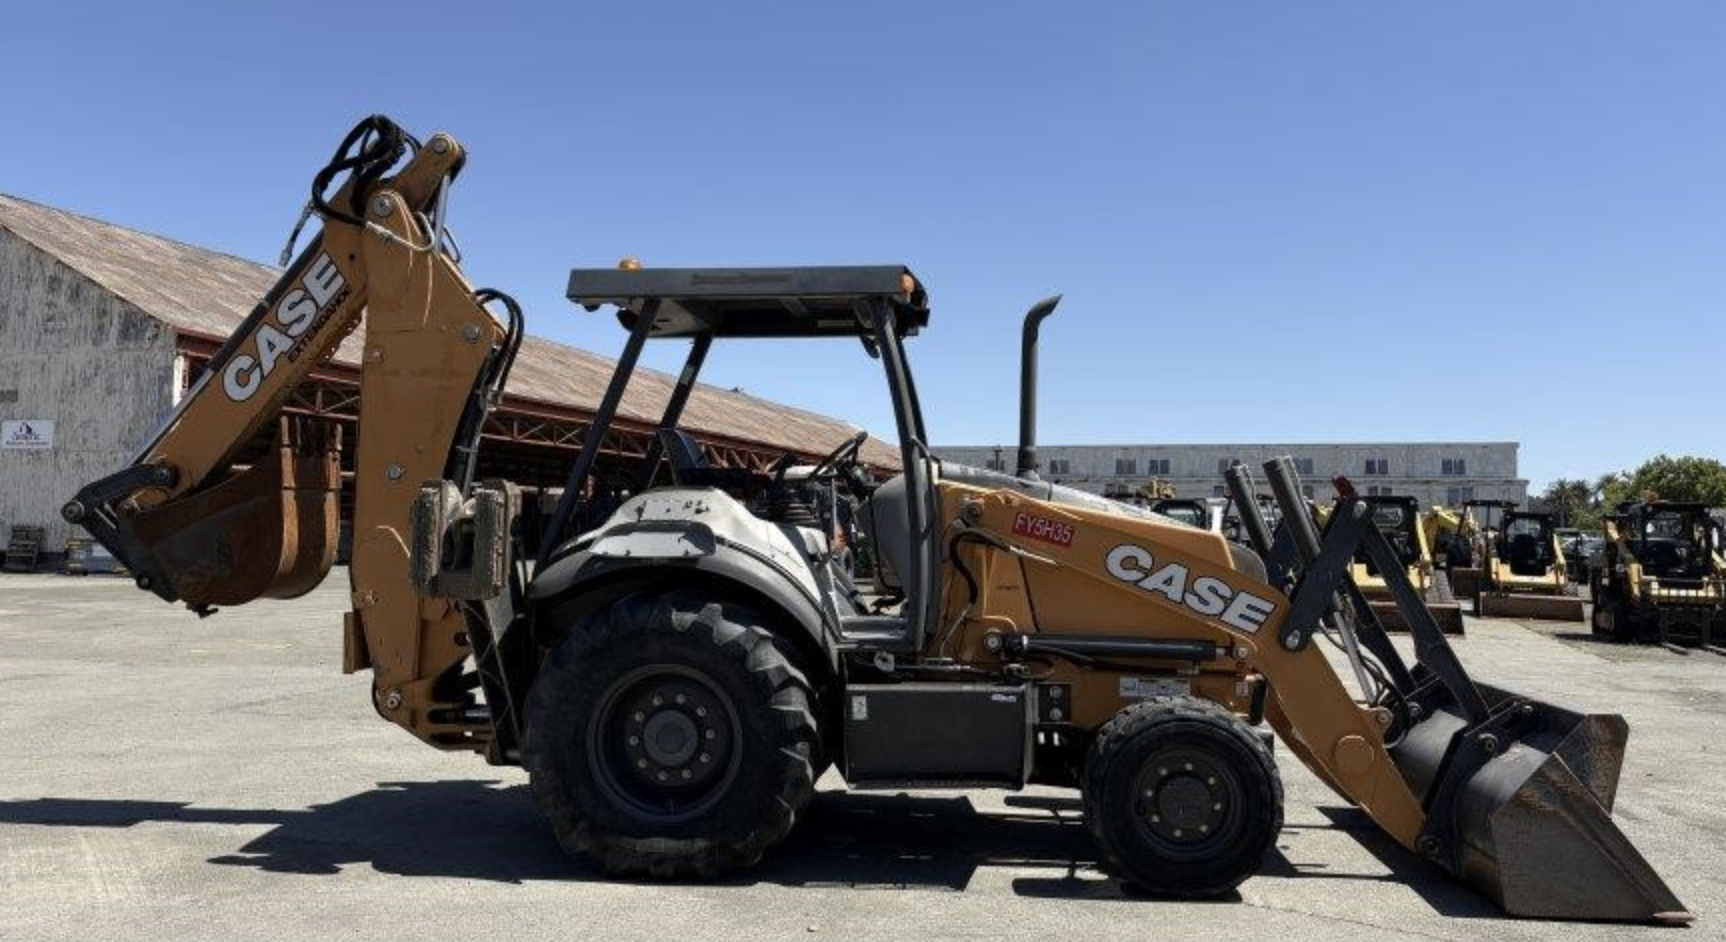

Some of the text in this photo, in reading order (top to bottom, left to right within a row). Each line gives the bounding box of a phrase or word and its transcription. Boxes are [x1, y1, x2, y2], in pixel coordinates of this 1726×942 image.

[223, 251, 346, 401] CASE
[1015, 513, 1072, 543] FY5H35
[1105, 544, 1275, 634] CASE
